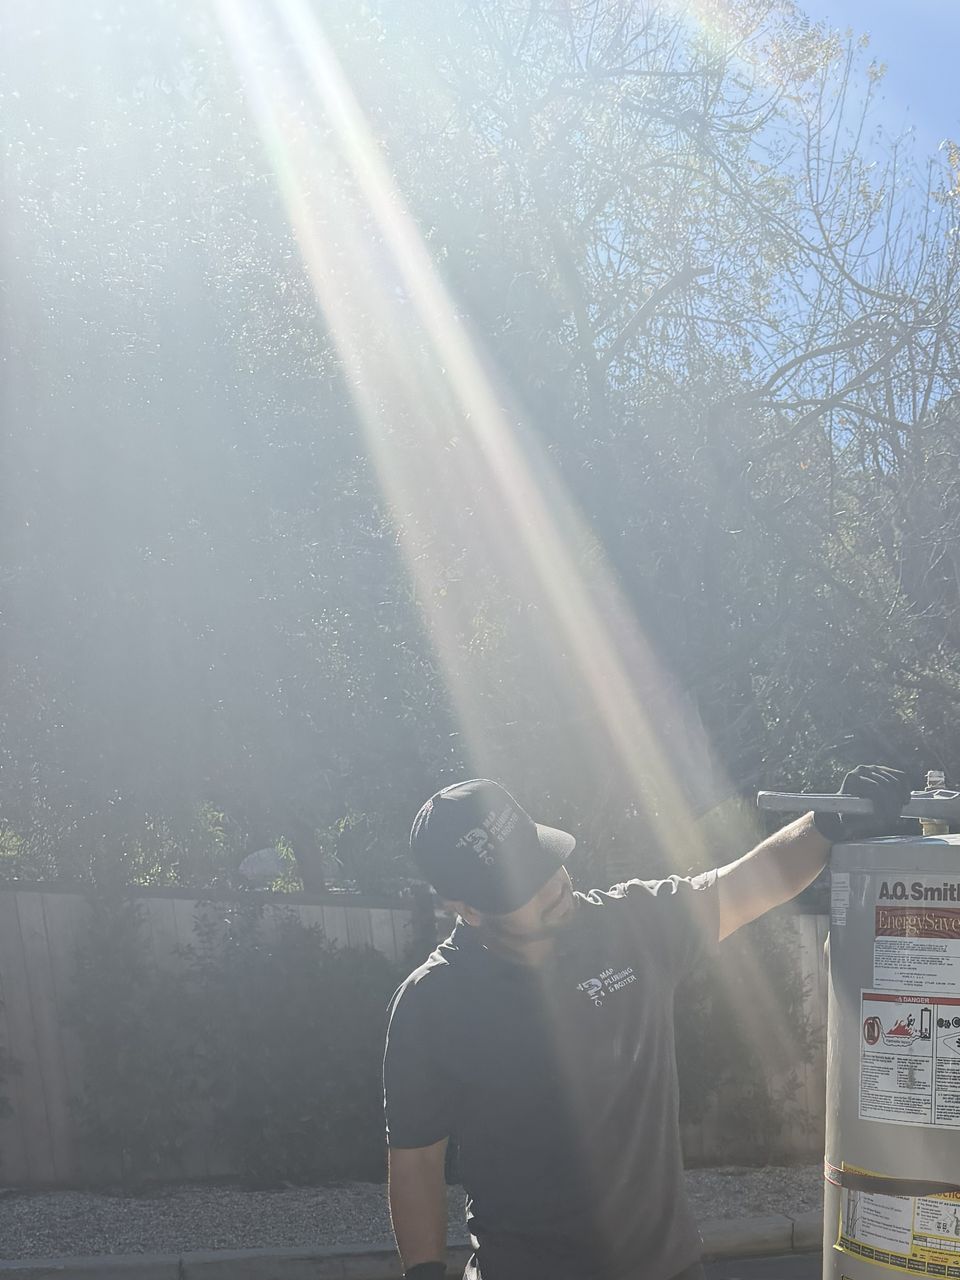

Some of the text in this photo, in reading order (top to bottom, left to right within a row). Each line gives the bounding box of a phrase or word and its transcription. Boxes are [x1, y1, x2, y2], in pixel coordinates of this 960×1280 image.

[879, 881, 908, 901] A.O.
[599, 968, 614, 980] MAP
[614, 975, 637, 990] ROOTER
